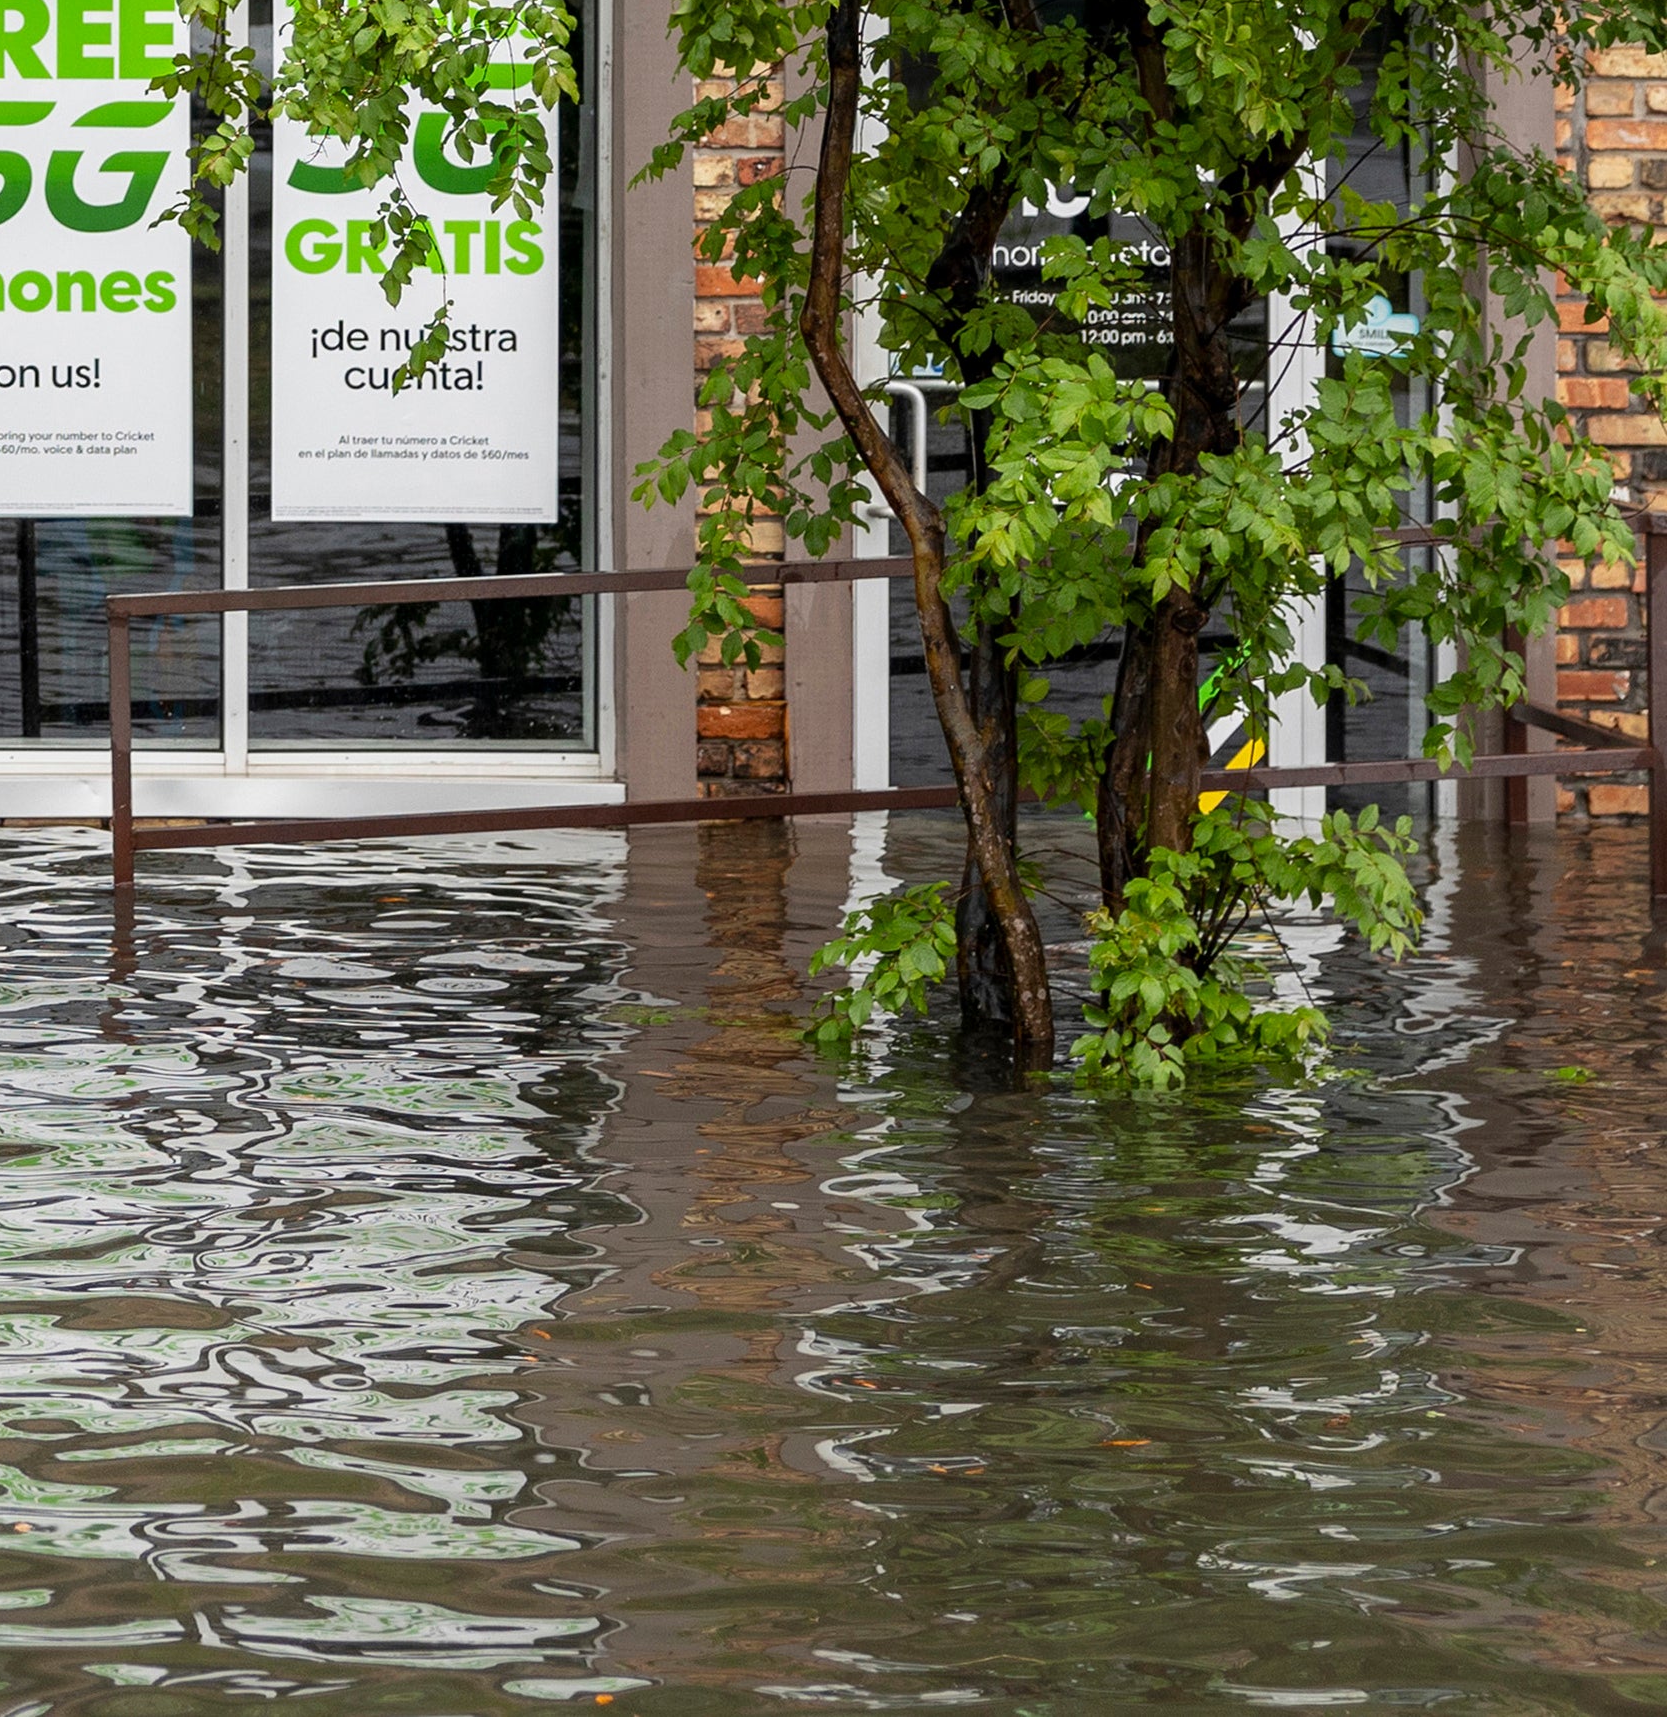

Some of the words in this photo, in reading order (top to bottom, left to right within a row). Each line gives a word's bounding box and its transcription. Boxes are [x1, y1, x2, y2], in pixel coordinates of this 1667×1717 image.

[1012, 290, 1056, 307] Friday
[380, 324, 517, 352] nustra
[1080, 329, 1119, 344] 12:00
[1121, 332, 1147, 346] pm
[52, 358, 101, 388] us!
[28, 433, 53, 443] your
[55, 431, 98, 442] number
[101, 432, 113, 442] to
[115, 431, 155, 442] Cricket
[338, 435, 350, 445] Al
[352, 436, 379, 445] traer
[381, 436, 393, 445] tu
[395, 435, 438, 445] número
[449, 435, 489, 445] Cricket
[43, 445, 73, 454] voice
[75, 445, 84, 454] &
[86, 445, 111, 454] data
[113, 445, 137, 457] plan
[298, 451, 313, 459] en
[315, 449, 326, 459] el
[327, 449, 351, 462] plan
[353, 450, 368, 459] de
[370, 449, 419, 459] llamadas
[421, 451, 429, 461] y
[430, 450, 461, 460] datos
[463, 450, 478, 460] de
[480, 449, 529, 461] $60/mes
